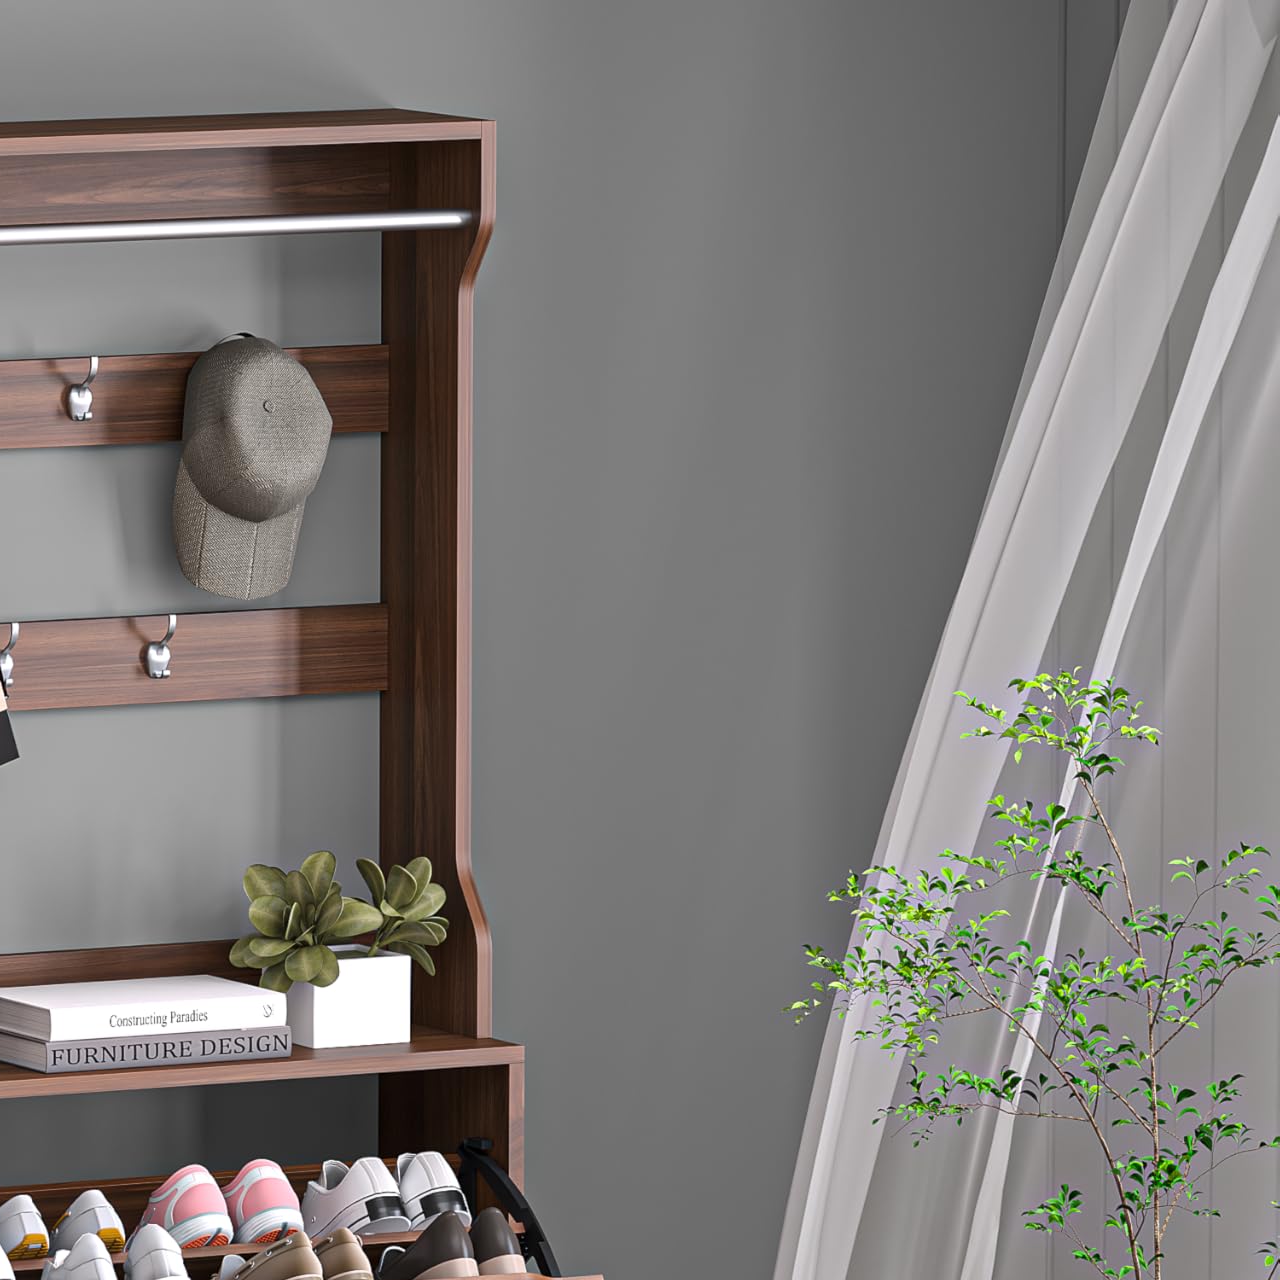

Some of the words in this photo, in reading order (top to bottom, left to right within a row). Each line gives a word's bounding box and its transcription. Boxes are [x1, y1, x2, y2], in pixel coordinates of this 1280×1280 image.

[109, 1011, 168, 1028] Constructing
[170, 1009, 208, 1024] Paradies
[51, 1040, 193, 1066] FURNITURE
[200, 1033, 289, 1057] DESIGN
